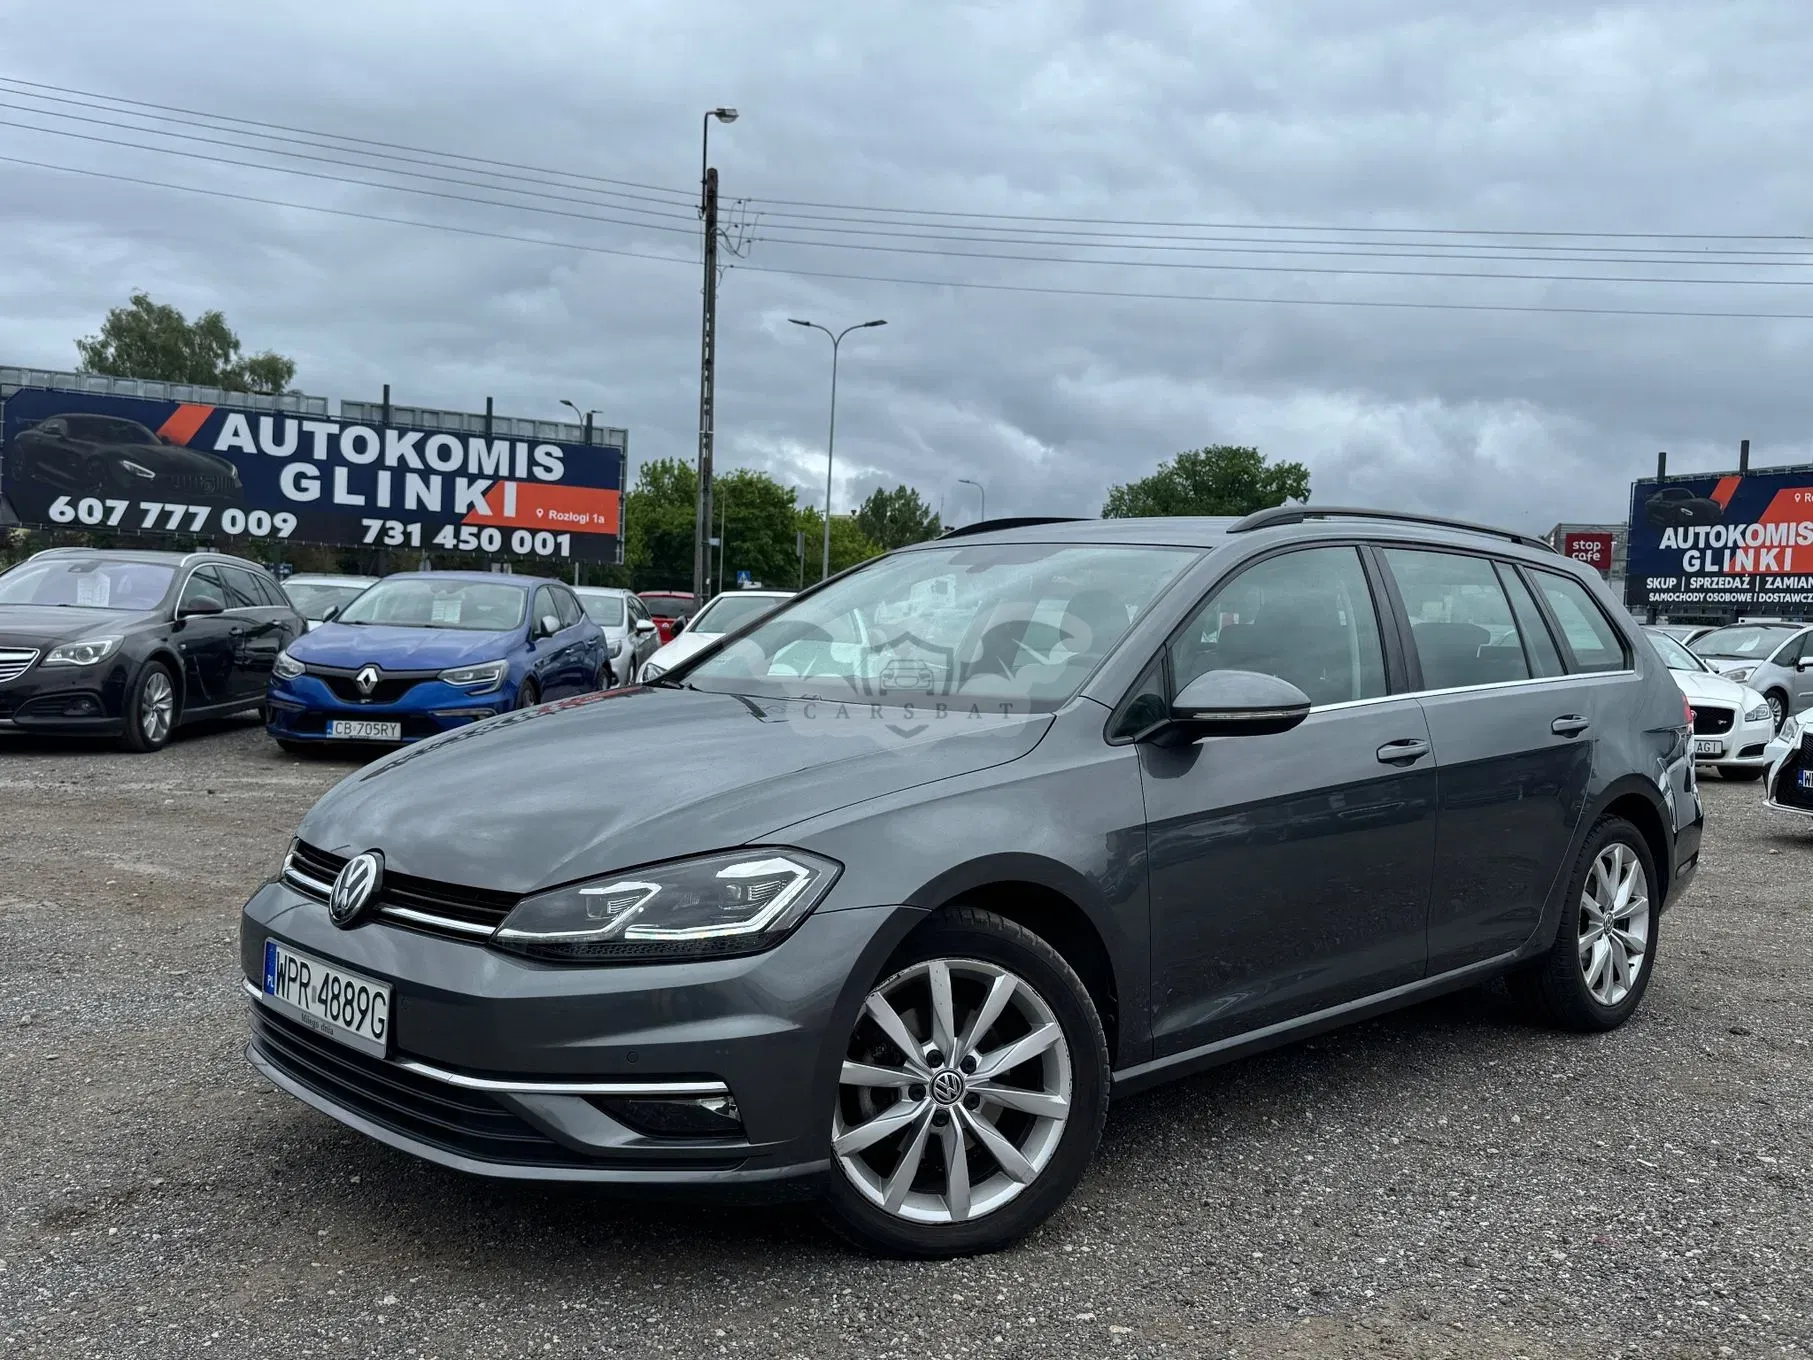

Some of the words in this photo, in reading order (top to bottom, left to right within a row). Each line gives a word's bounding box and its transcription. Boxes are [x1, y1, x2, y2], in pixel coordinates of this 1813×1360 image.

[213, 412, 565, 482] AUTOKOMIS
[280, 462, 517, 518] GLINKI
[48, 494, 131, 527] 607
[140, 501, 212, 533] 777
[221, 507, 298, 539] 009
[592, 513, 606, 525] 1a
[361, 518, 422, 548] 731
[433, 523, 502, 553] 450
[511, 529, 571, 557] 001
[1572, 540, 1601, 552] stop
[1658, 521, 1813, 550] AUTOKOMIS
[1572, 551, 1601, 562] cafe
[1683, 547, 1793, 573] GLINKI
[1646, 577, 1677, 589] SKUP
[1689, 573, 1751, 589] SPRZEDAŻ
[1648, 592, 1706, 602] SAMOCHODY
[1706, 592, 1753, 602] OSOBOWE
[1753, 592, 1758, 602] I
[335, 722, 352, 735] CB
[356, 722, 397, 737] 705RY
[266, 974, 275, 988] PL
[276, 951, 312, 1010] WPR
[317, 972, 387, 1040] 4889G
